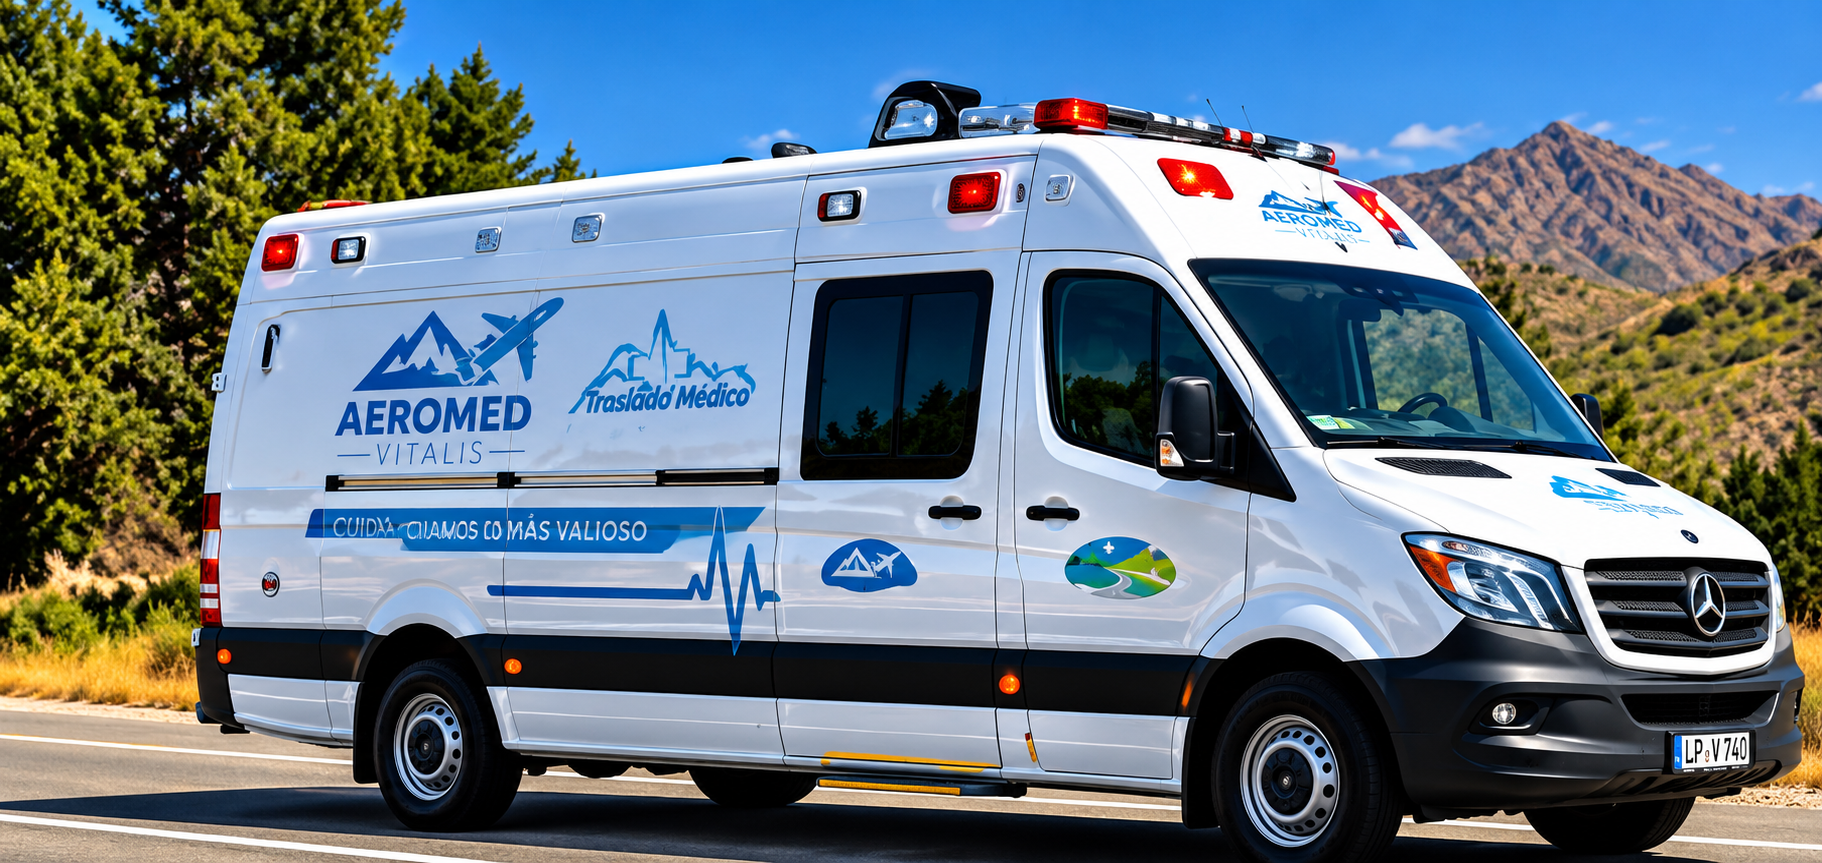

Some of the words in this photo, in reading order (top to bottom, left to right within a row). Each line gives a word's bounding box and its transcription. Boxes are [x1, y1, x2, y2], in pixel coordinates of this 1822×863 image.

[1262, 210, 1362, 233] AEROMED
[586, 384, 675, 414] Traslado
[675, 382, 750, 410] Médico
[335, 395, 532, 436] AEROMED
[377, 440, 482, 465] VITALIS
[556, 520, 648, 542] VALIOSO
[1685, 738, 1703, 763] LP
[1711, 738, 1720, 762] V
[1724, 736, 1747, 762] 740
